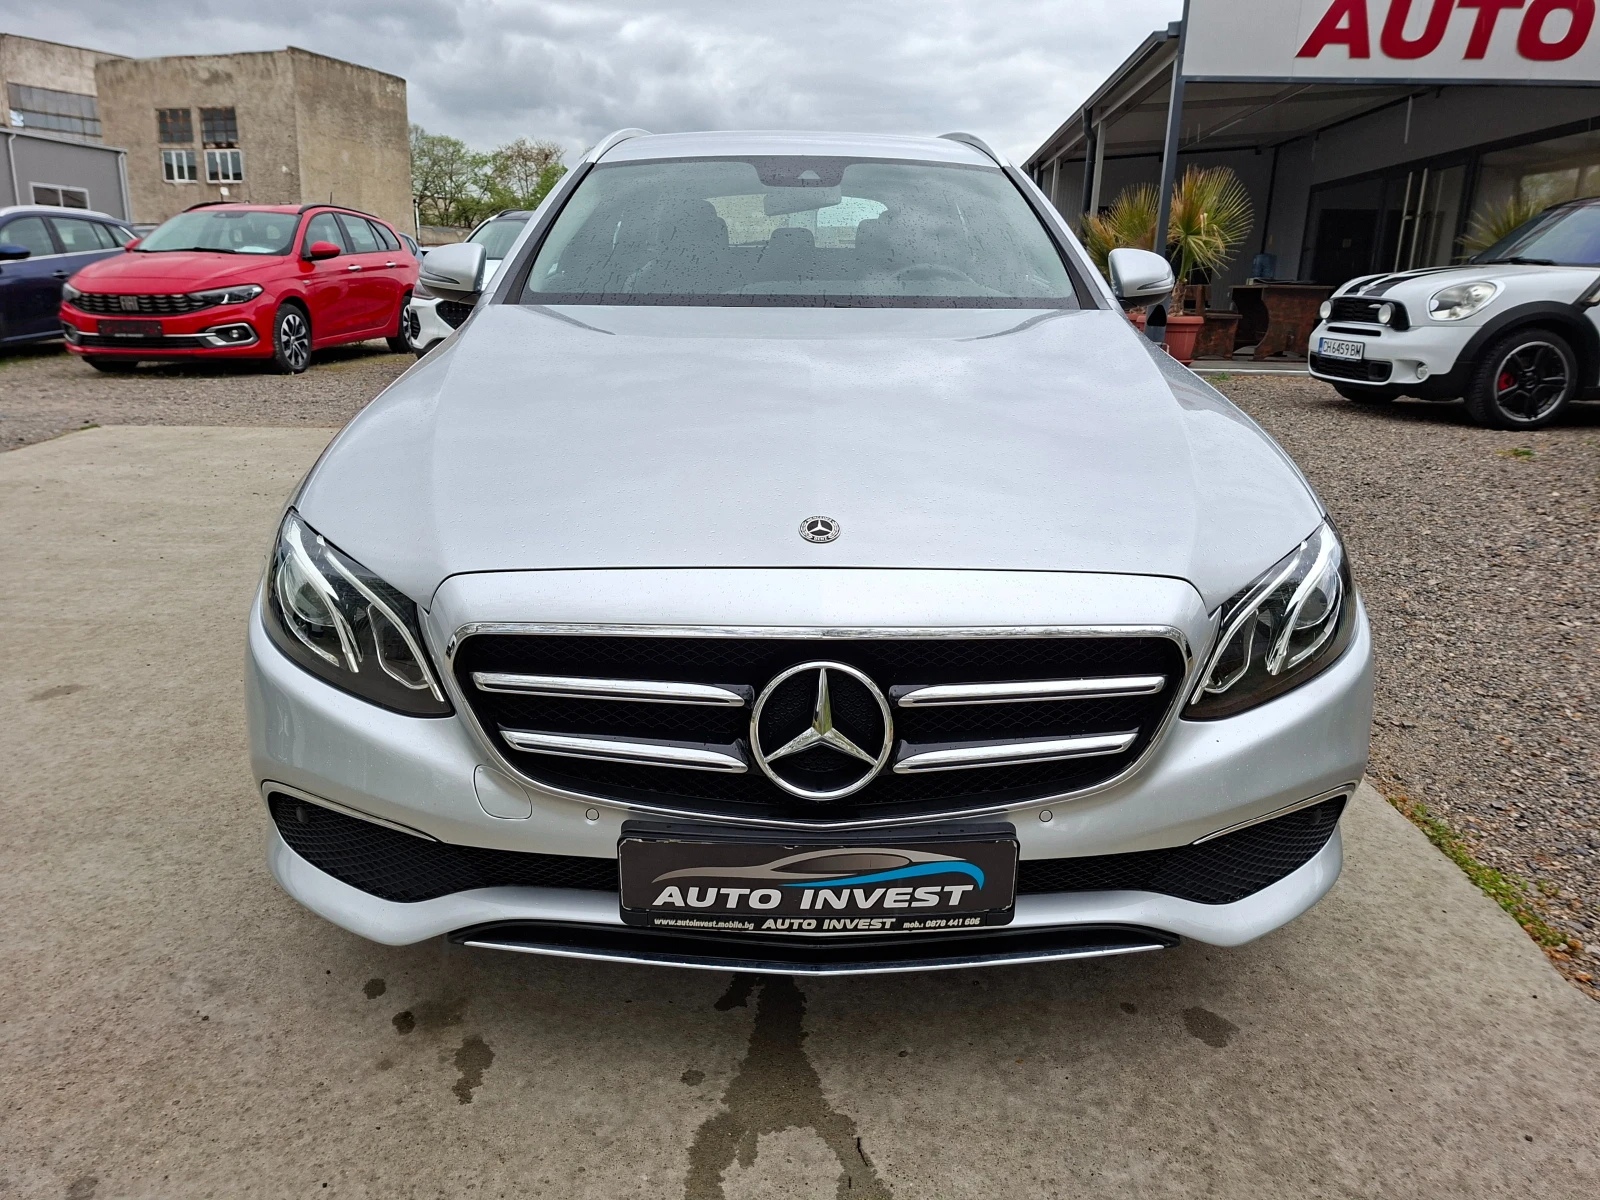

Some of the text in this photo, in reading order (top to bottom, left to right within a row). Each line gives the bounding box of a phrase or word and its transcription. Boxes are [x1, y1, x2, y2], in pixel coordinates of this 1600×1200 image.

[1295, 0, 1596, 61] AUTO
[652, 885, 974, 910] AUTO INVEST
[761, 918, 817, 930] AUTO
[822, 917, 896, 930] INVEST
